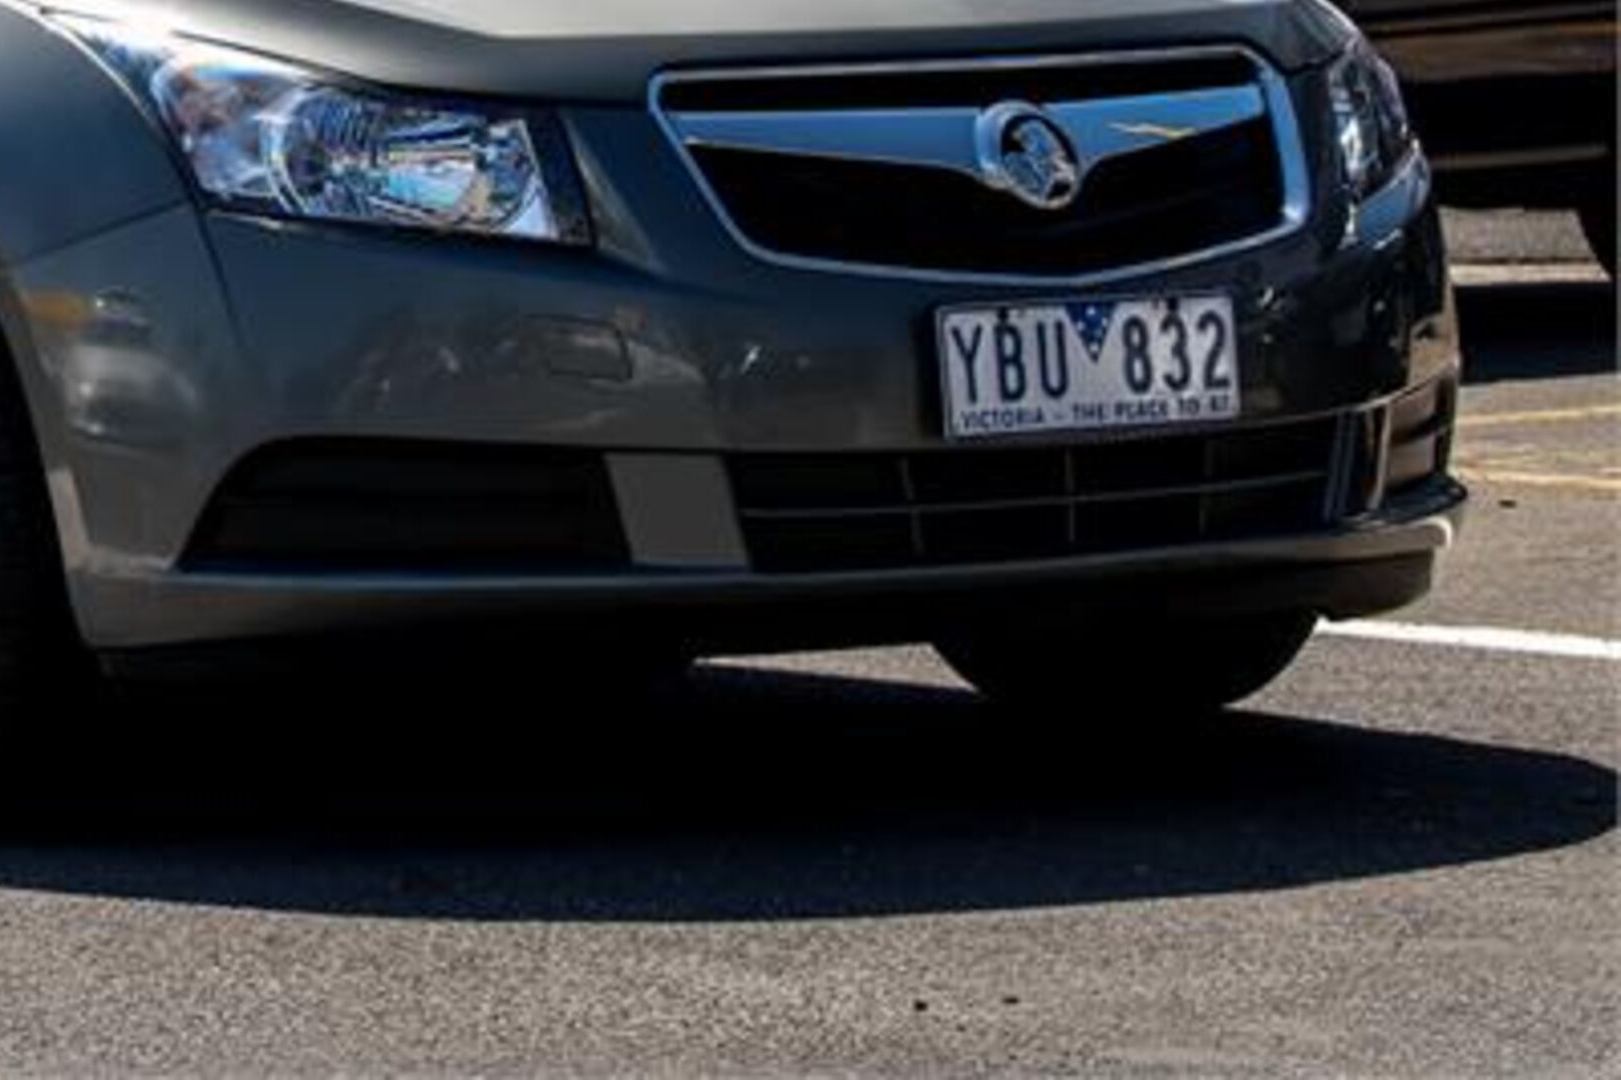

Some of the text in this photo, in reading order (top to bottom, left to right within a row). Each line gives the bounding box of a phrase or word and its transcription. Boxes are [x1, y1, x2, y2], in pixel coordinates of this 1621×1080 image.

[950, 310, 1231, 403] YBU 832
[960, 407, 1046, 431] VICTORIA
[1071, 403, 1105, 422] THE
[1114, 398, 1170, 420] PLACE
[1176, 396, 1202, 415] TO
